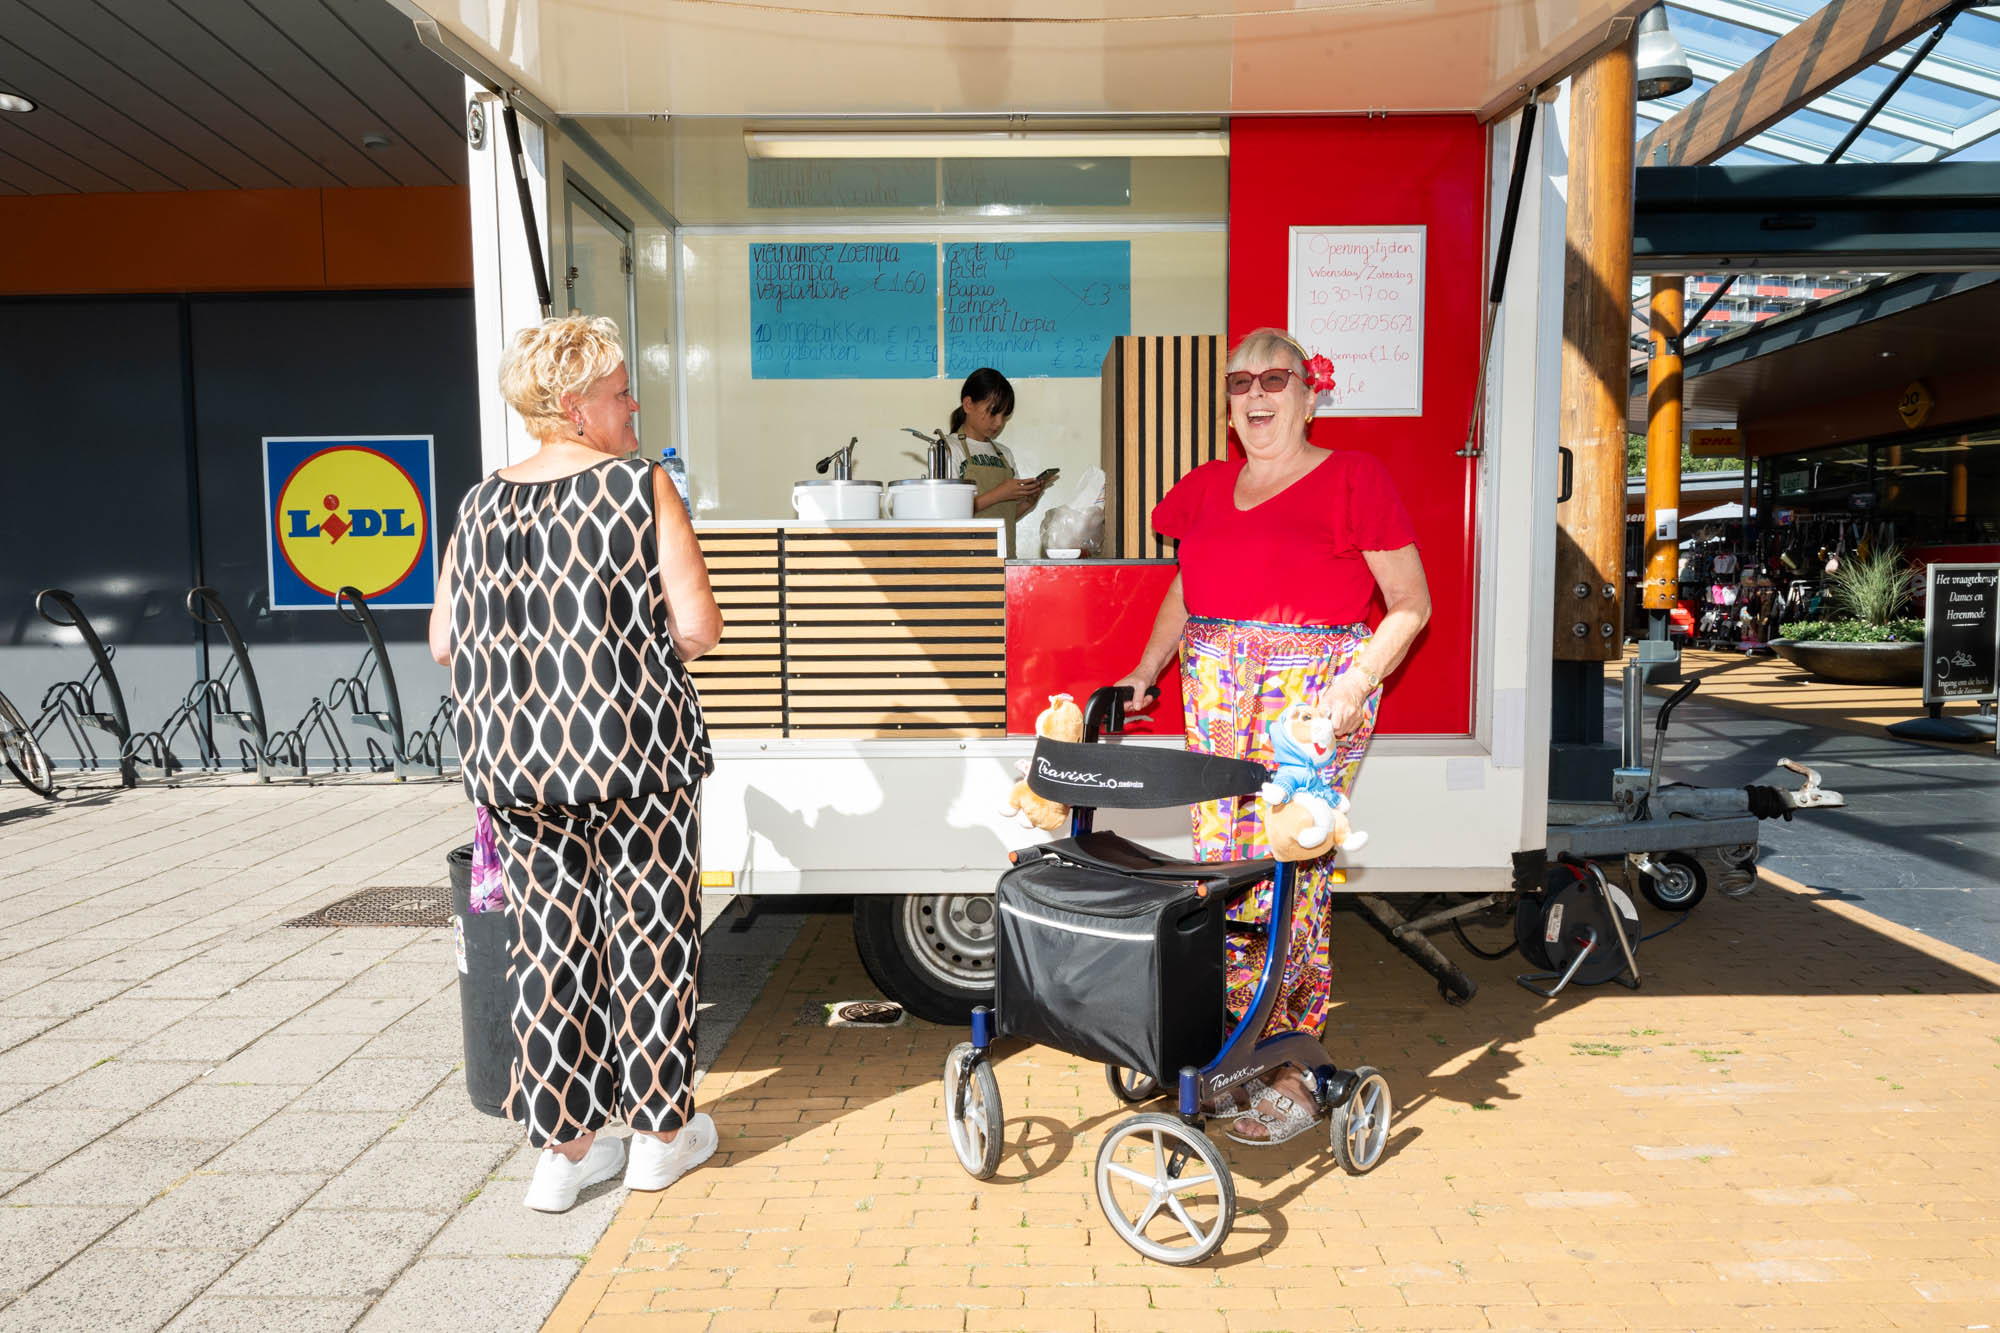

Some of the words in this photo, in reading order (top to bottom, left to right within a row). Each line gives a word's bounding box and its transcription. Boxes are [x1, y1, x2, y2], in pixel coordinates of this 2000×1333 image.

[1309, 234, 1414, 264] Openingstijden
[1936, 574, 1950, 585] Het
[1949, 592, 1973, 602] Dames
[1974, 593, 1983, 601] en
[1946, 608, 1987, 620] Herenmode
[1036, 756, 1102, 783] Travixx
[1209, 1065, 1249, 1092] Travixx
